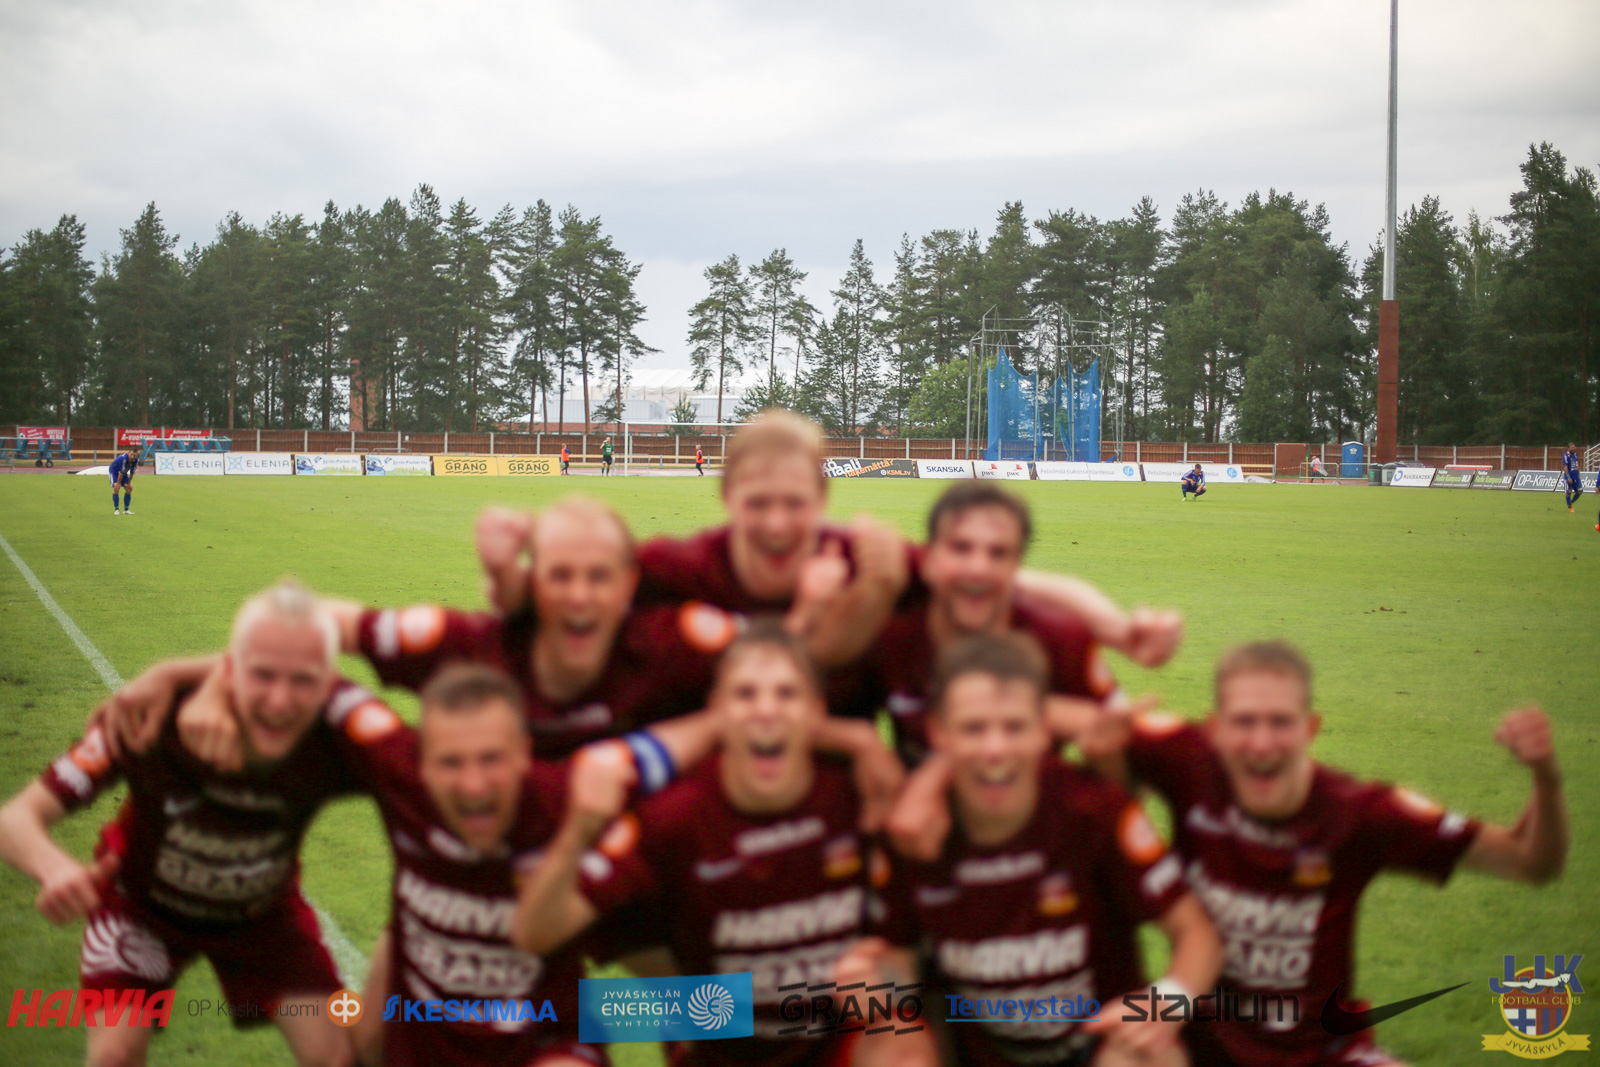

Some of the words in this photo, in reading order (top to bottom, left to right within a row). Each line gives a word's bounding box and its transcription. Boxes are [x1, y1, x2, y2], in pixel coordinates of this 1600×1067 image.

[178, 460, 222, 468] ELENIA
[246, 460, 290, 468] ELENIA
[445, 462, 487, 471] GRANO
[509, 463, 550, 472] GRANO
